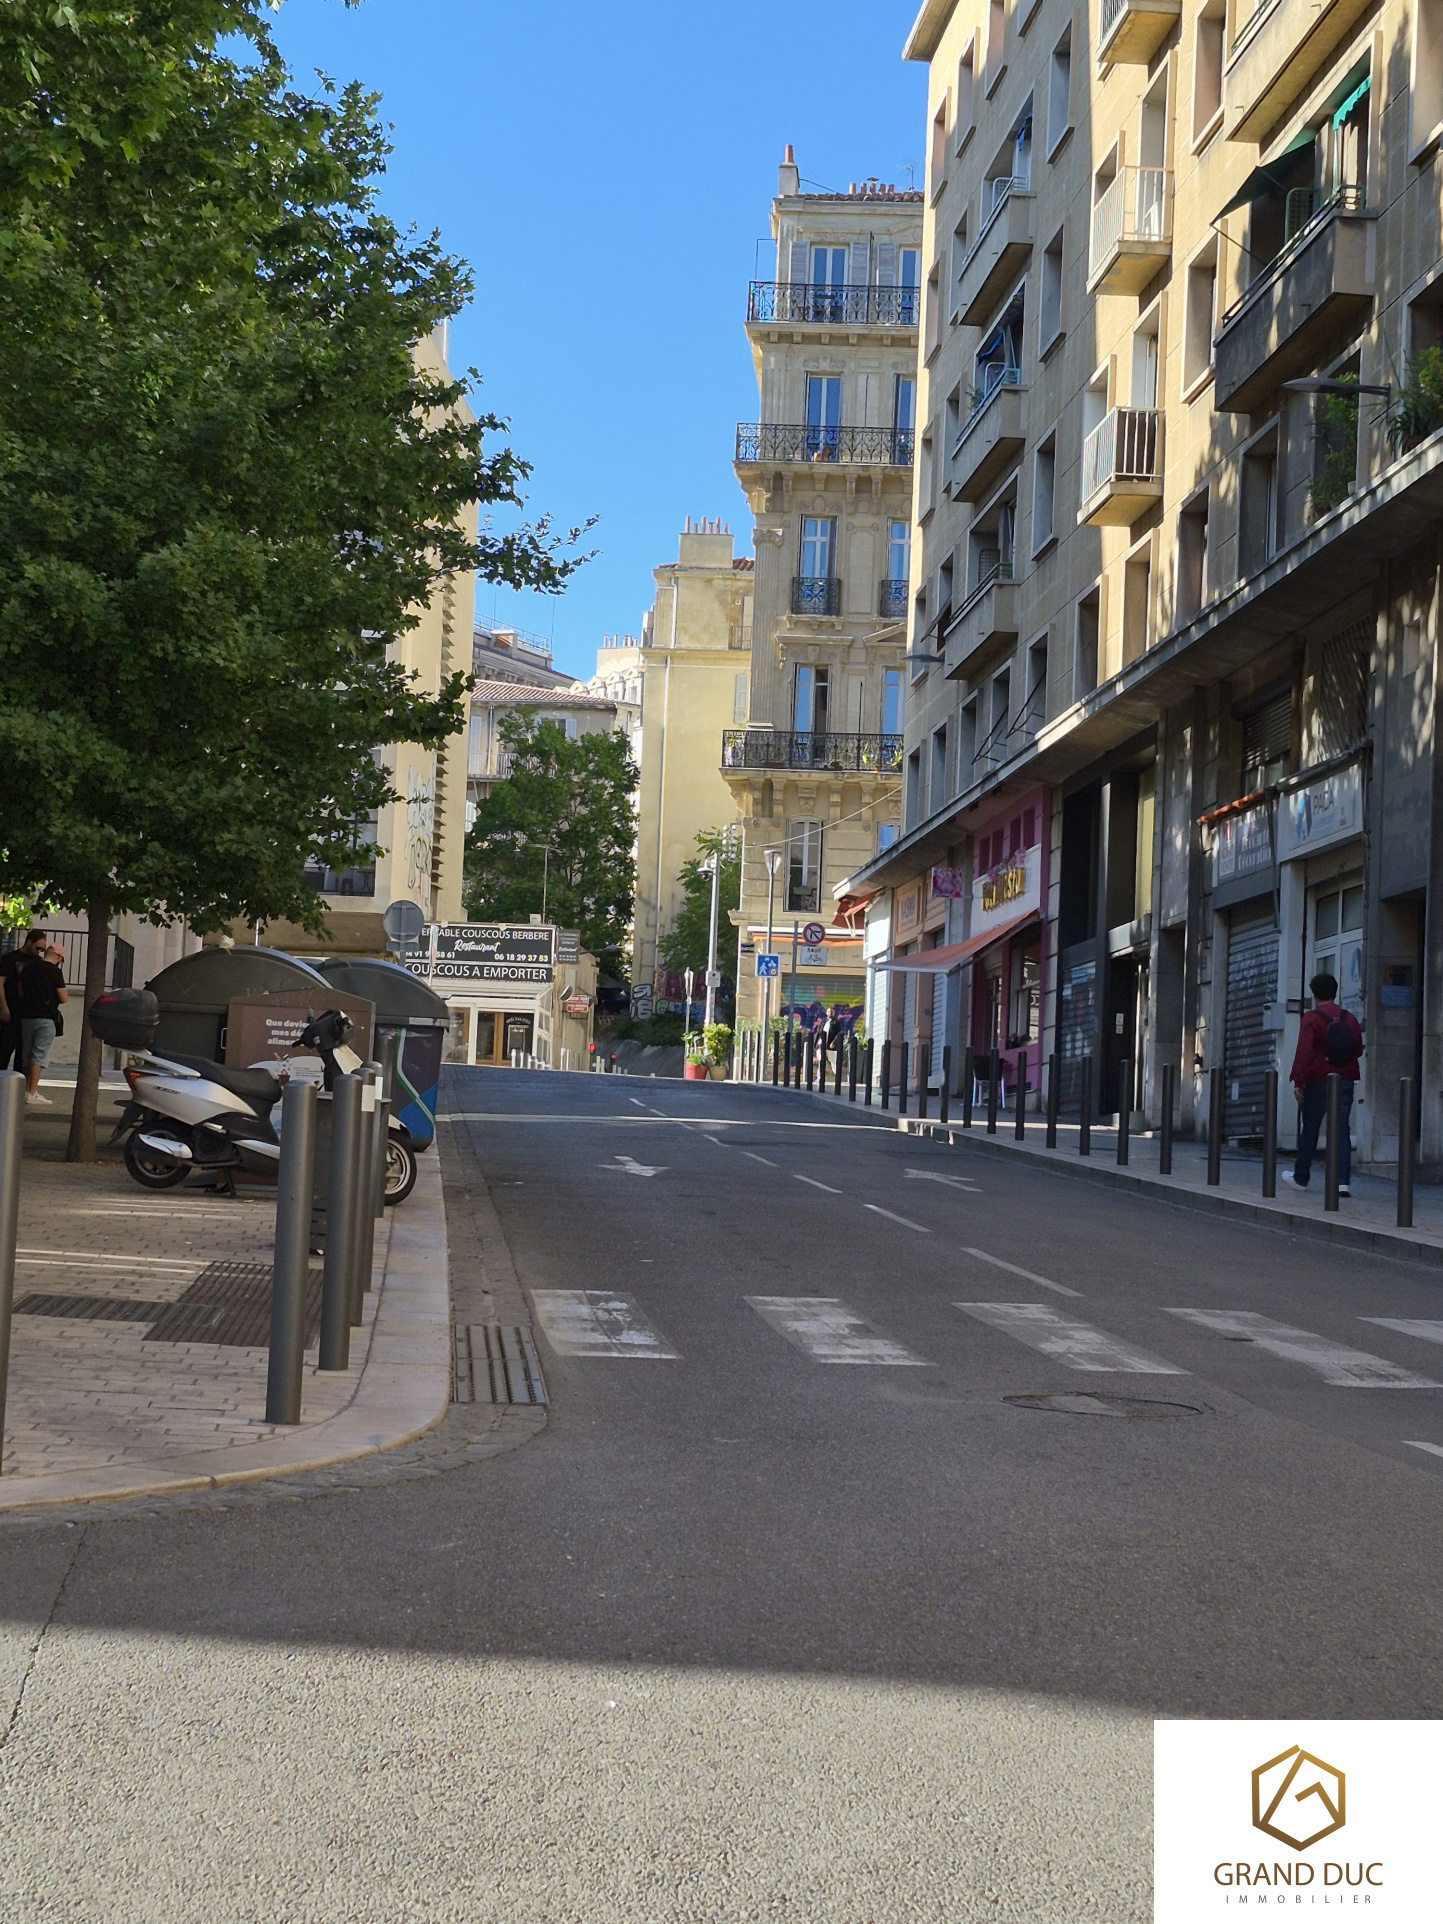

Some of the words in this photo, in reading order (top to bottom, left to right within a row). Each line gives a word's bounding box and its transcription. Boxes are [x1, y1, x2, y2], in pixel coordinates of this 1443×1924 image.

[1313, 789, 1334, 815] PACA
[462, 929, 510, 939] COUSCOUS
[512, 931, 549, 941] BERBERE
[454, 939, 501, 953] Restaurant
[494, 953, 504, 961] 06
[472, 966, 480, 976] A
[483, 966, 546, 980] EMPORTER
[265, 1019, 283, 1027] Que
[291, 1029, 303, 1037] dé
